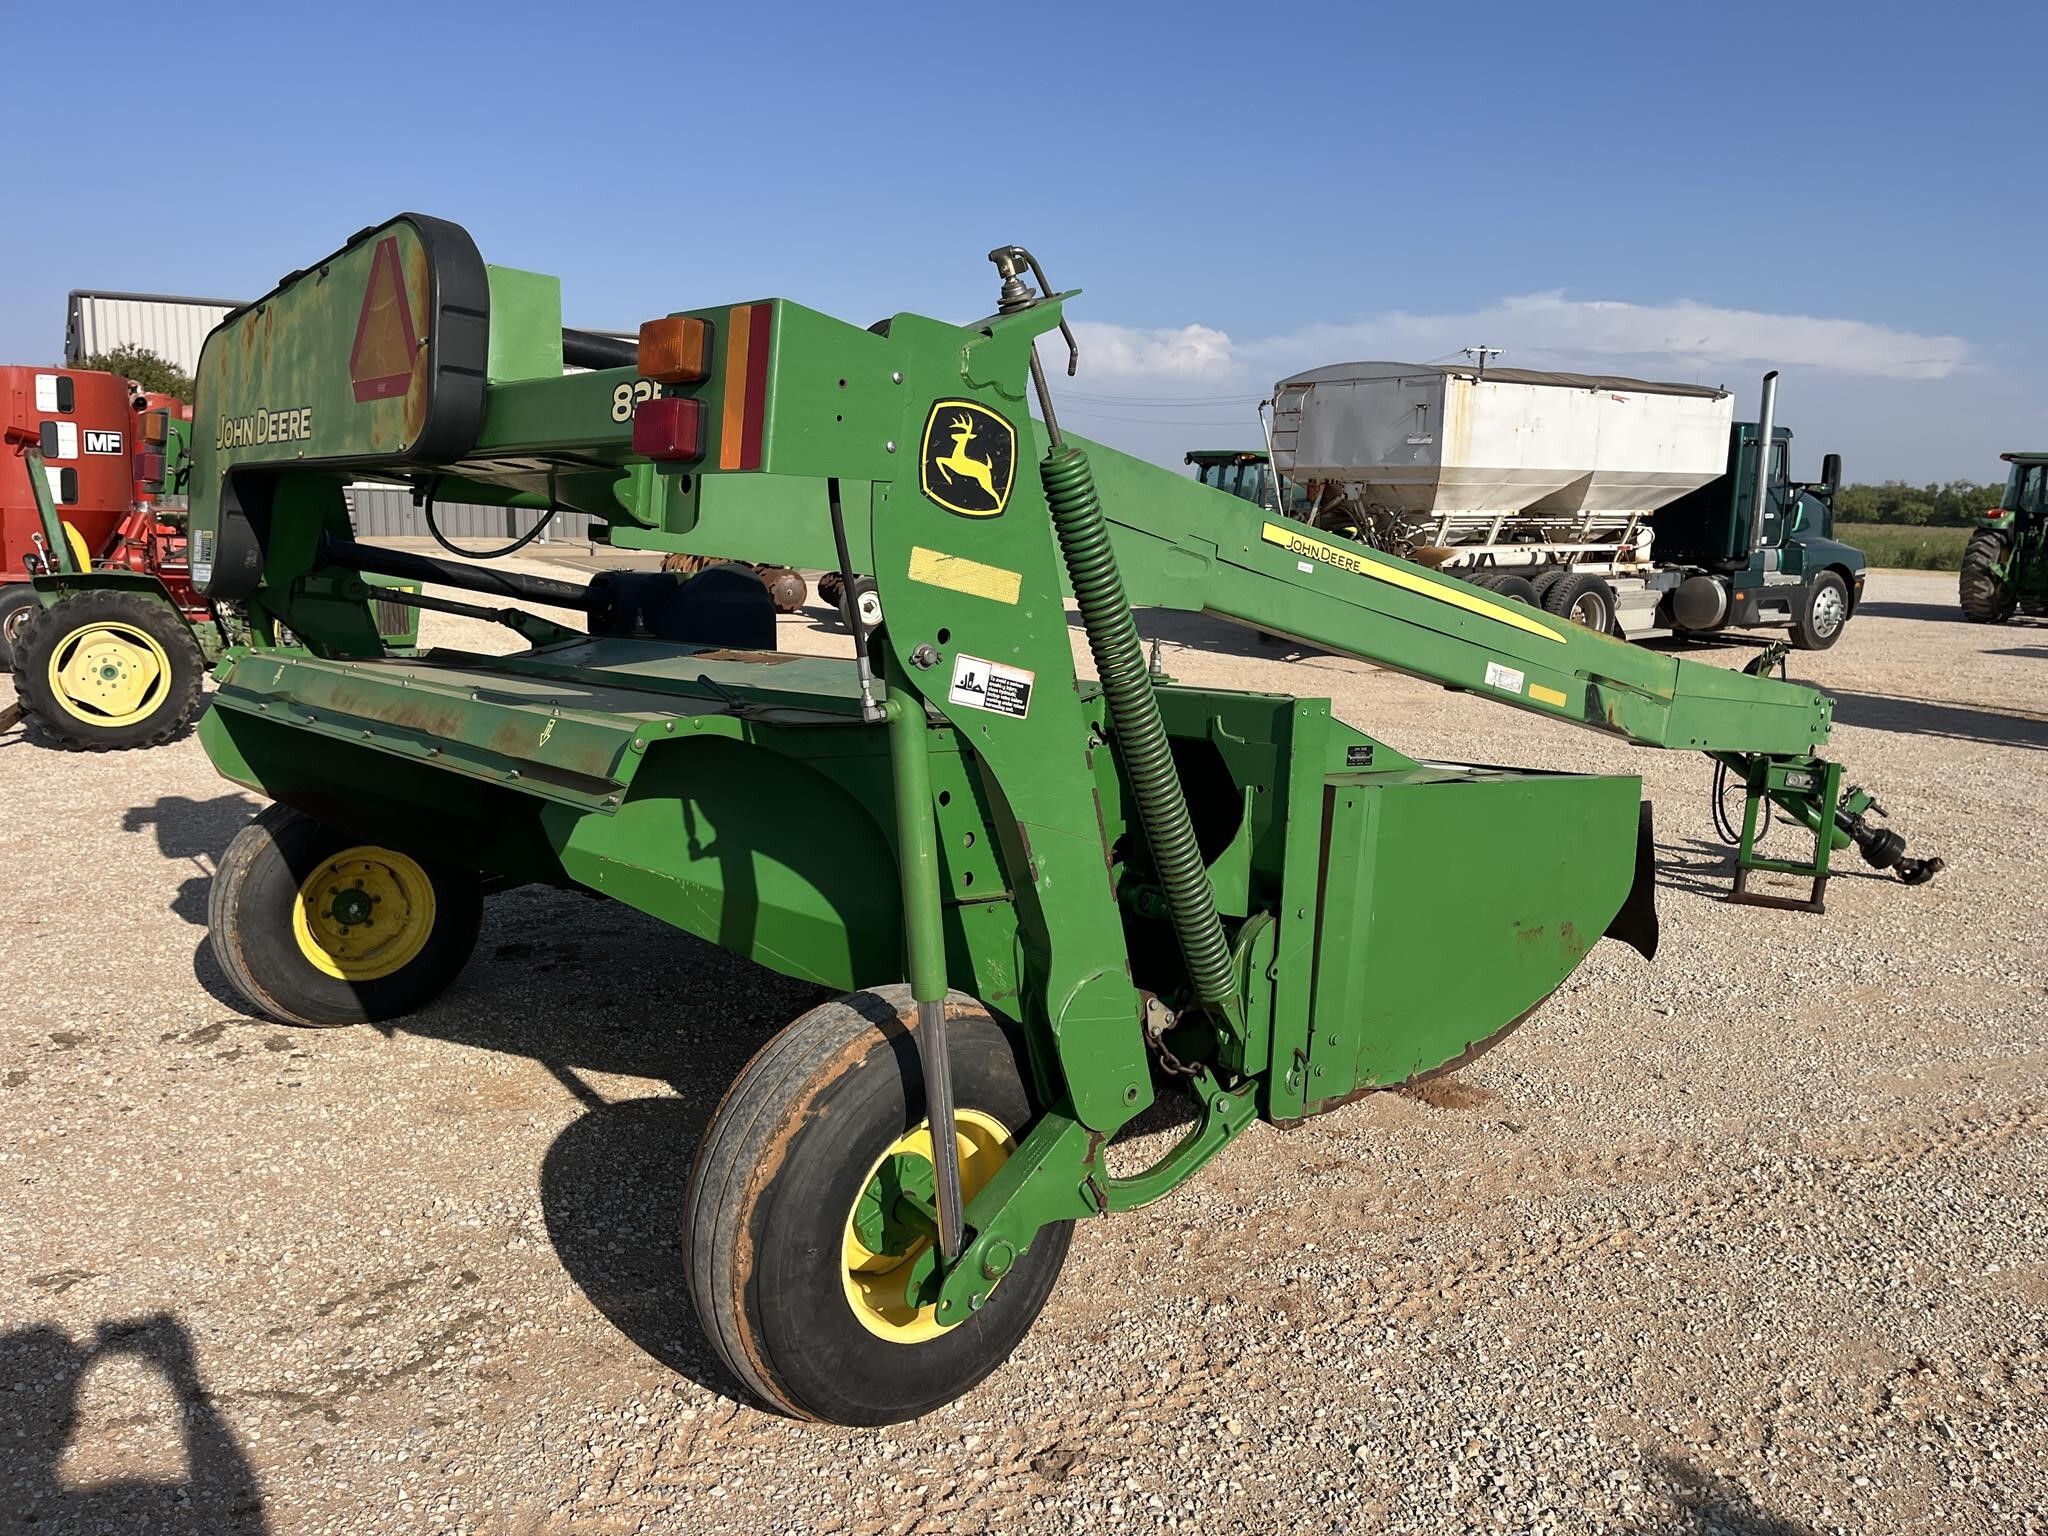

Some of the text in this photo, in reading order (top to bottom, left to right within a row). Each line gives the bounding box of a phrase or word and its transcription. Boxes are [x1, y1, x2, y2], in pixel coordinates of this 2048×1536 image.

[87, 432, 120, 452] MF
[216, 406, 312, 451] JOHN DEERE
[1286, 536, 1361, 572] JOHN DEERE
